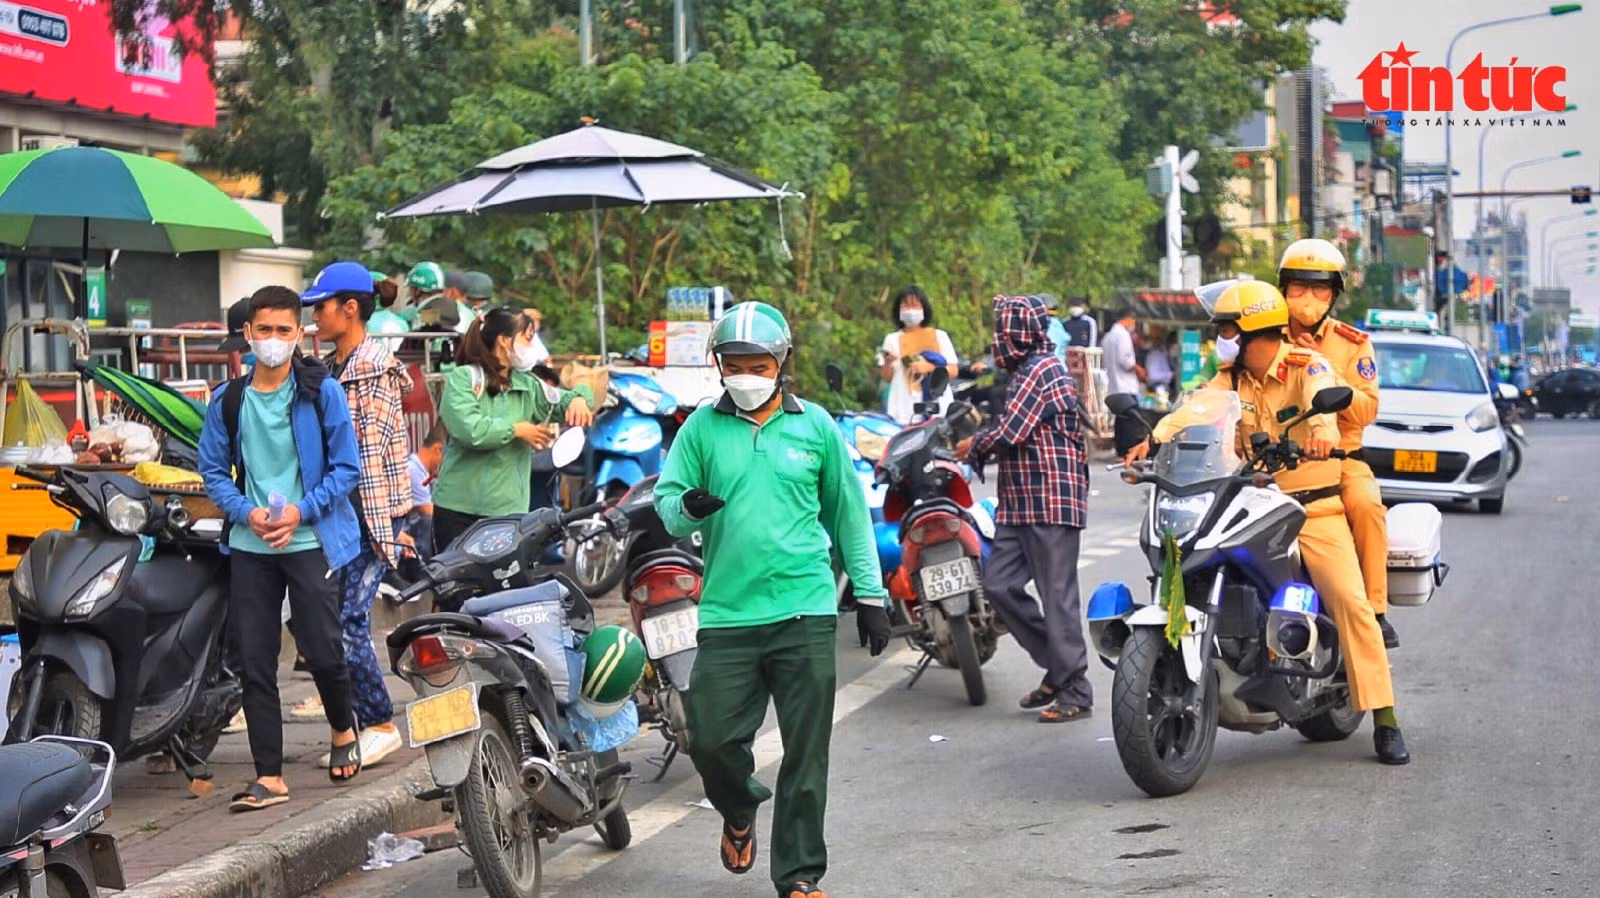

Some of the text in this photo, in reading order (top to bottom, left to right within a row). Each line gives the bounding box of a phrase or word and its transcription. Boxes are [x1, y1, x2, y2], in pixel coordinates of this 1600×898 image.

[89, 286, 99, 317] 4
[1242, 300, 1276, 317] CSGT
[534, 610, 550, 624] 8K
